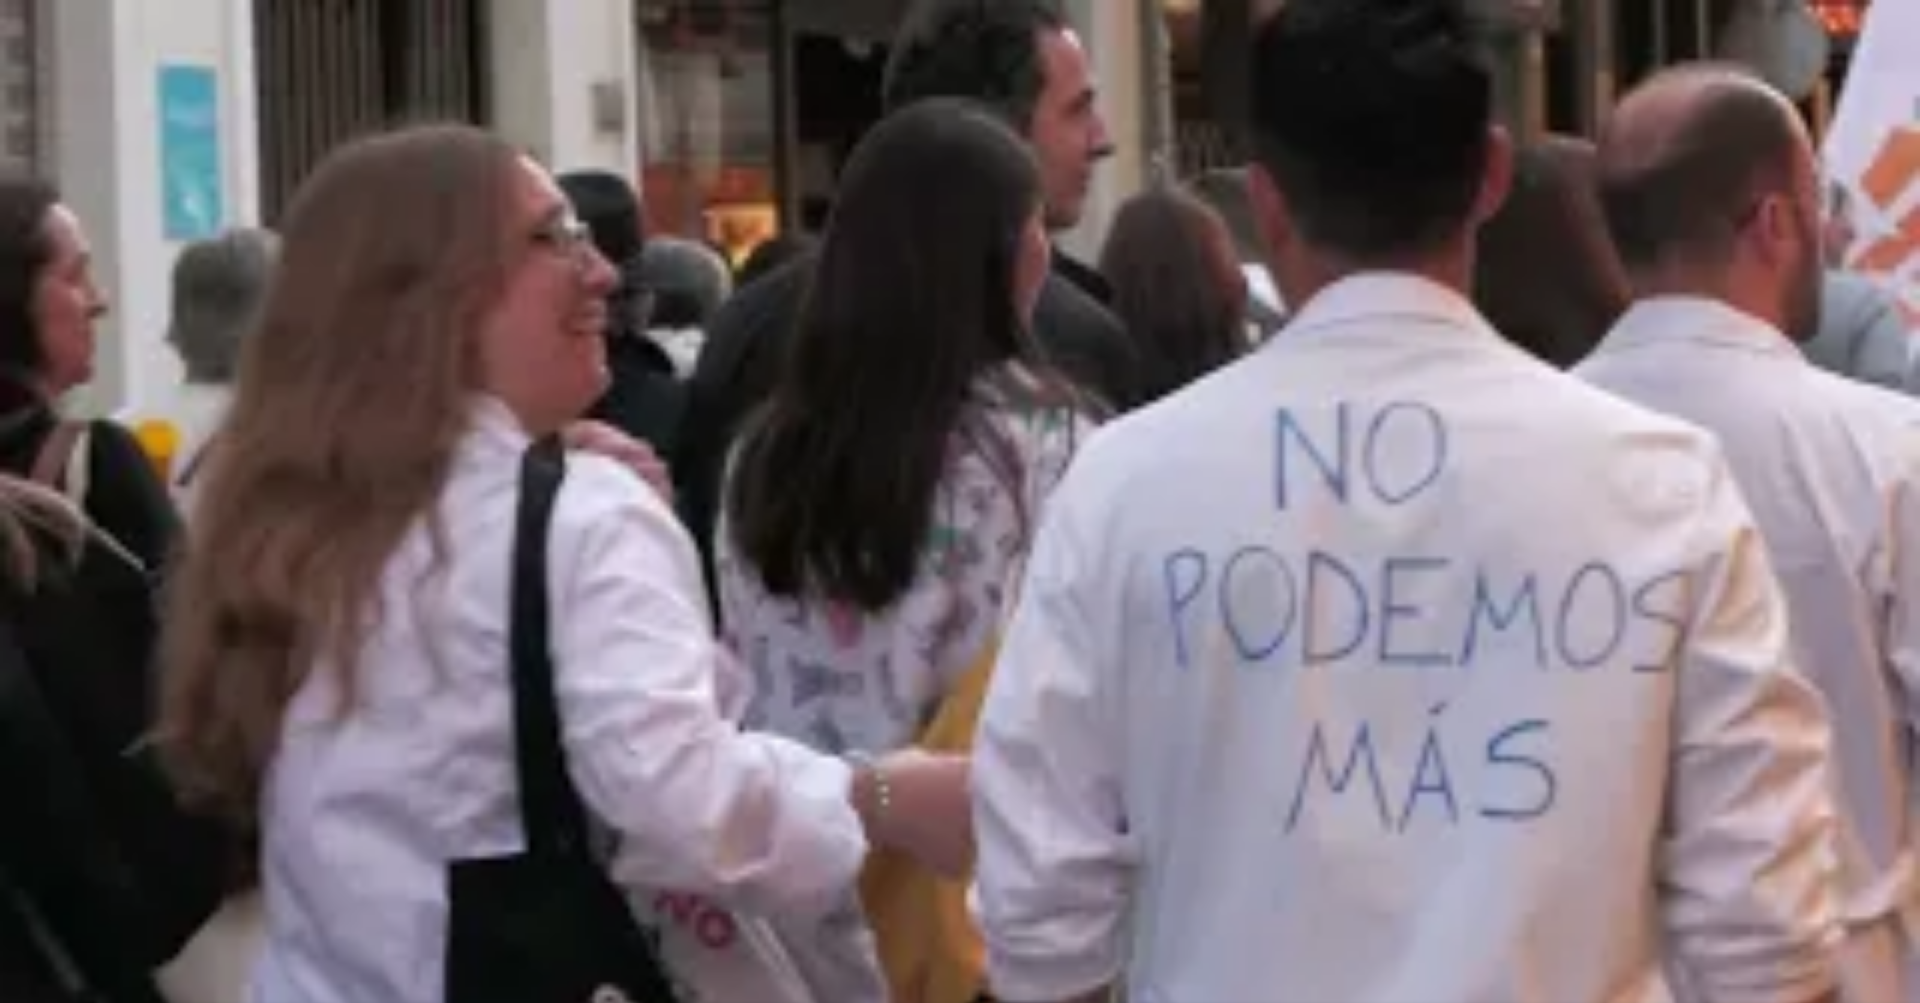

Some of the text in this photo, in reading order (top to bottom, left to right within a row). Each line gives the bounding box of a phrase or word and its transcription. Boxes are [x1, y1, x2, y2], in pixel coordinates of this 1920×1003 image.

[1274, 400, 1447, 509] NO
[1164, 545, 1692, 673] PODEMOS
[1284, 701, 1557, 834] MÁS
